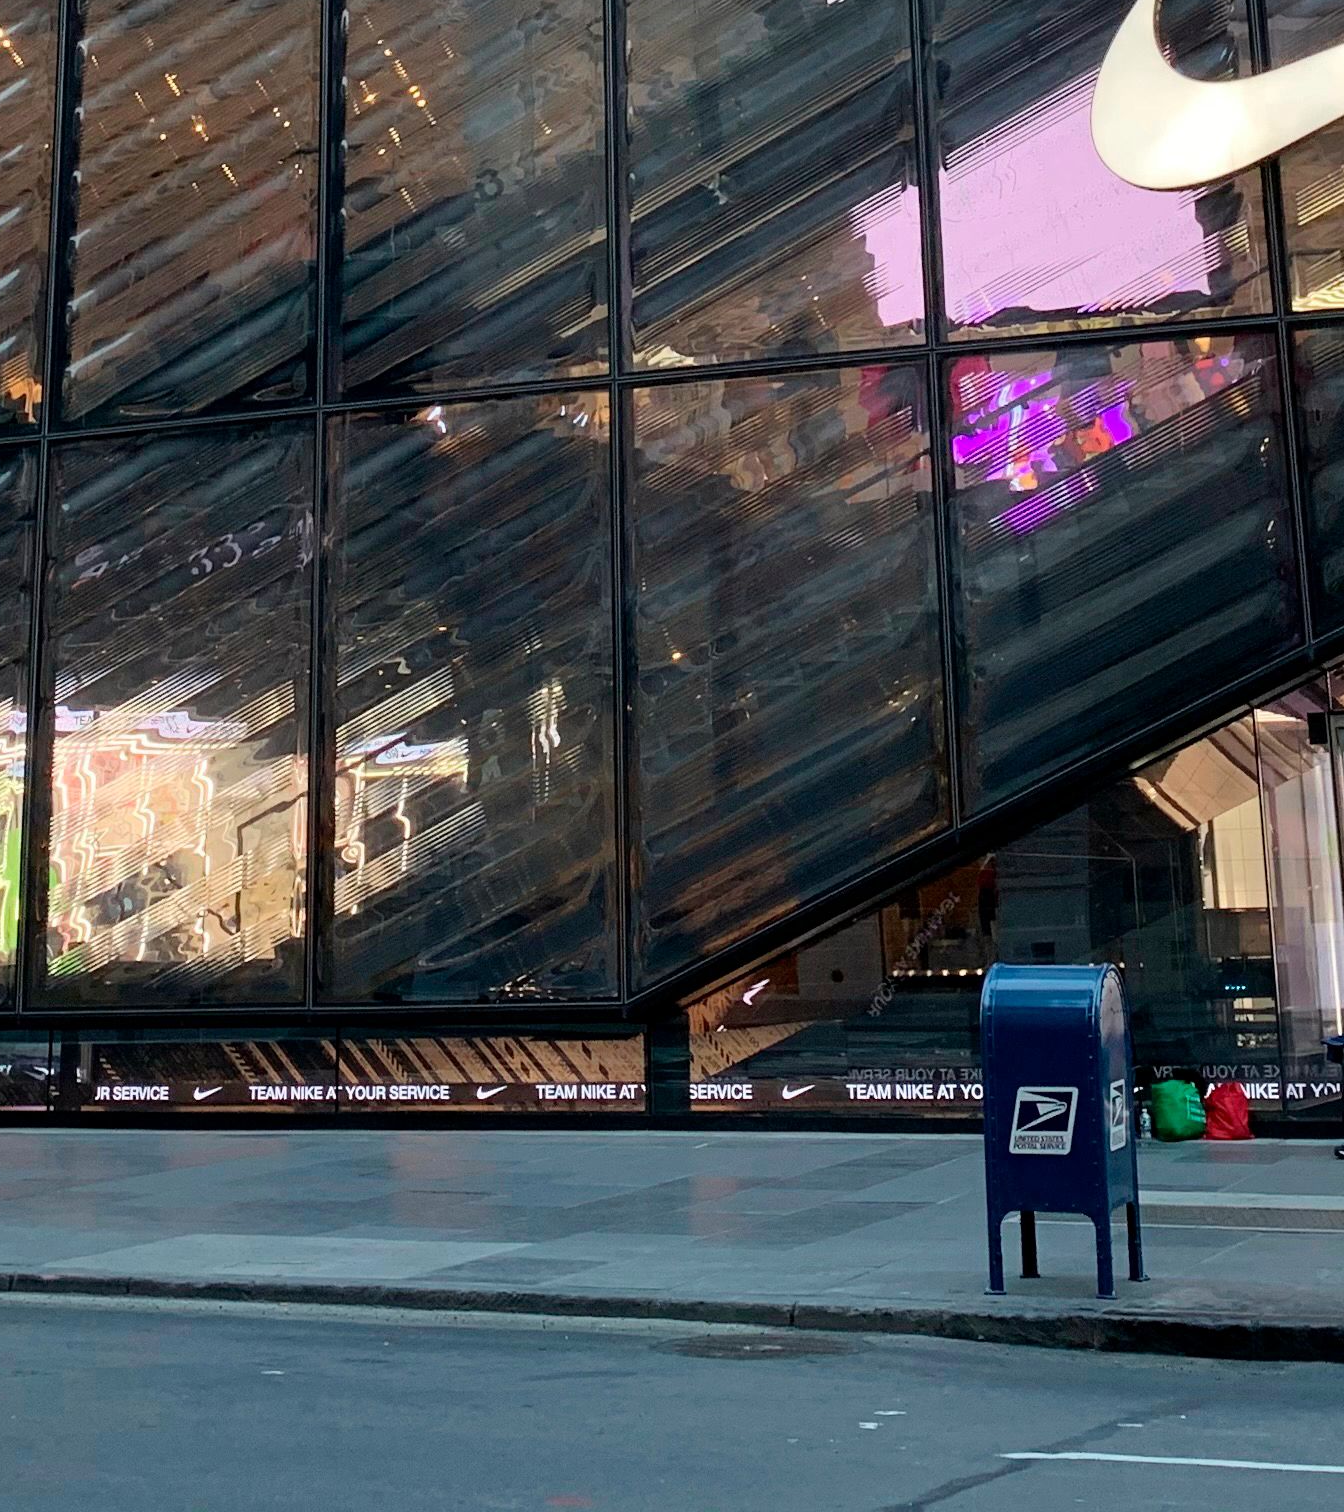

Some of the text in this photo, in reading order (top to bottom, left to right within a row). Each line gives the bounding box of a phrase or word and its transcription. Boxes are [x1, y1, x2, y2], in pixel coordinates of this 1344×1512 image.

[112, 1085, 170, 1101] SERVICE
[249, 1086, 288, 1100] TEAM
[290, 1086, 323, 1100] NIKE
[345, 1086, 387, 1100] YOUR
[388, 1085, 450, 1100] SERVICE
[535, 1084, 638, 1100] TEAM NIKE AT
[689, 1084, 753, 1100] SERVICE
[846, 1084, 892, 1100] TEAM
[895, 1084, 934, 1100] NIKE
[937, 1084, 958, 1100] AT
[1286, 1083, 1307, 1100] AT
[1013, 1142, 1066, 1150] POSTAL SERVICE
[1014, 1135, 1064, 1143] UNITED STATES
